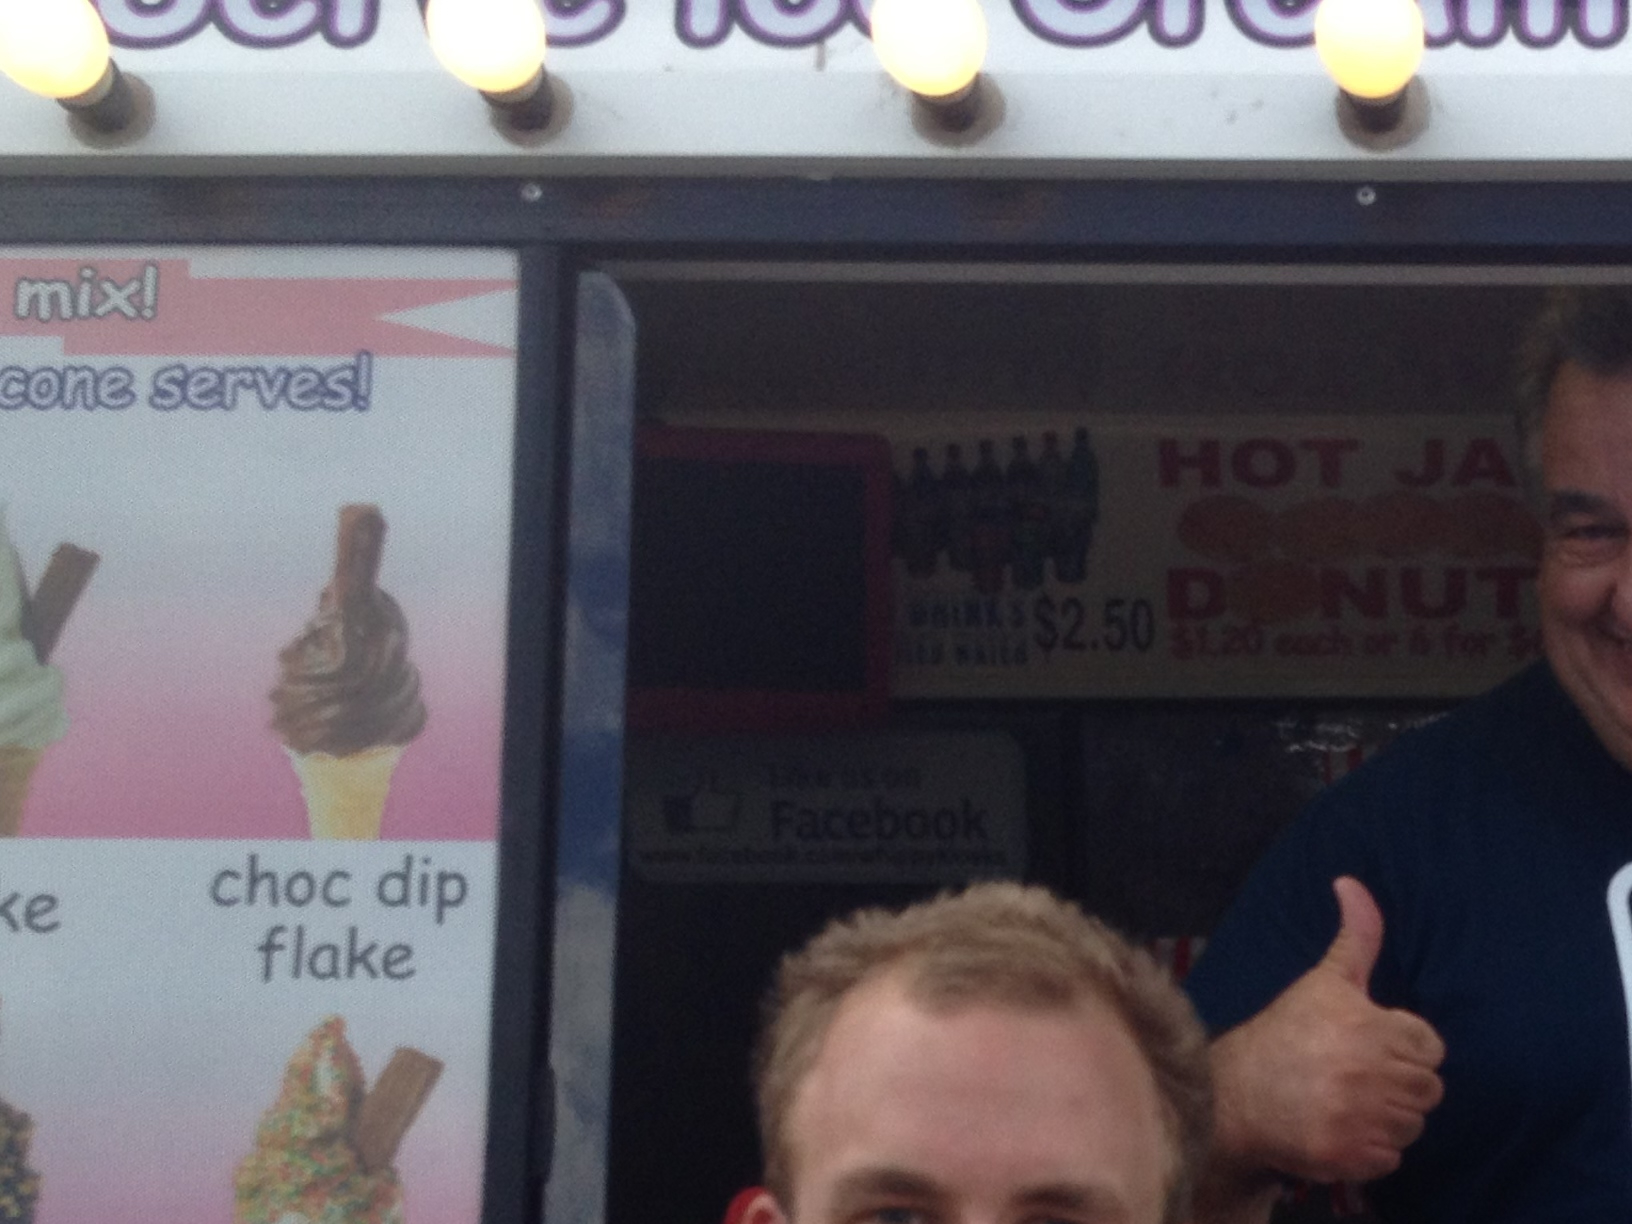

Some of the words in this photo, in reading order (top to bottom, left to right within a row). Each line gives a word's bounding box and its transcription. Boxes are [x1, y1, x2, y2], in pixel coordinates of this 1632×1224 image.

[14, 260, 159, 322] mix!
[0, 364, 136, 411] cone
[148, 350, 373, 411] serves!
[1157, 438, 1358, 488] HOT
[1393, 438, 1514, 488] JA
[1034, 594, 1156, 662] $2.50
[770, 797, 988, 842] Facebook
[209, 853, 353, 910] choc
[376, 855, 470, 925] dip
[256, 925, 417, 984] flake
